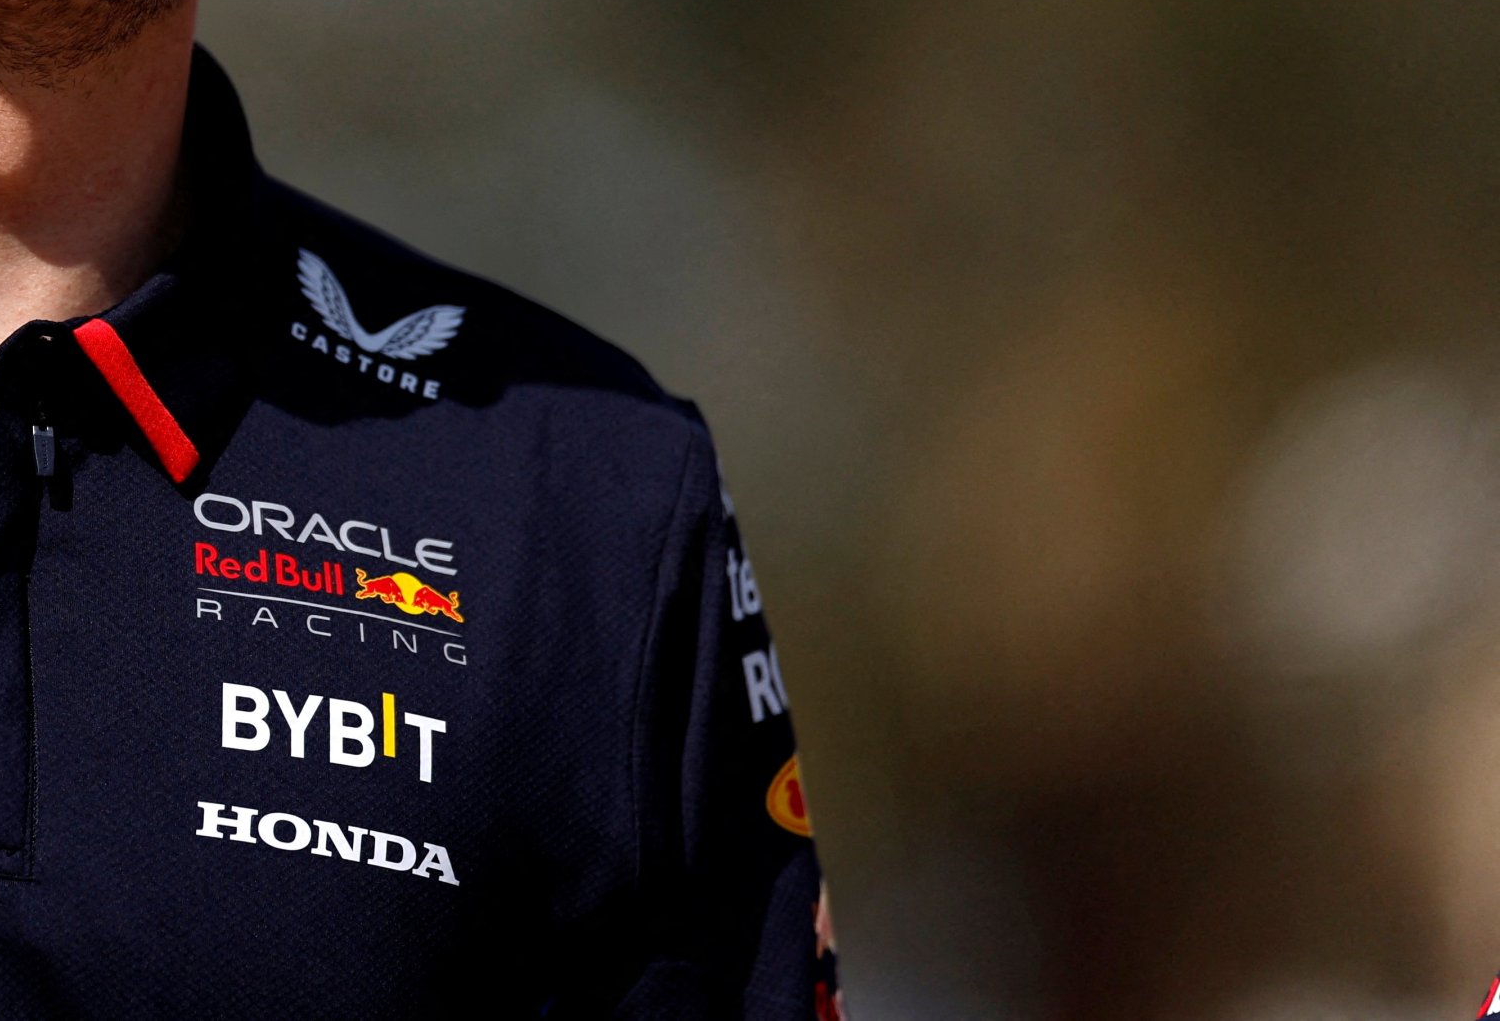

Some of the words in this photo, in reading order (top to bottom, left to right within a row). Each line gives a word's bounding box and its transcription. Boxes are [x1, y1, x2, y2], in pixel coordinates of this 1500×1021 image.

[291, 322, 441, 400] CASTORE
[193, 492, 458, 576] ORACLE
[193, 541, 269, 584] Red
[274, 552, 344, 596] Bull
[196, 598, 467, 666] RACING
[221, 682, 447, 784] BYBIT
[195, 800, 460, 886] HONDA
